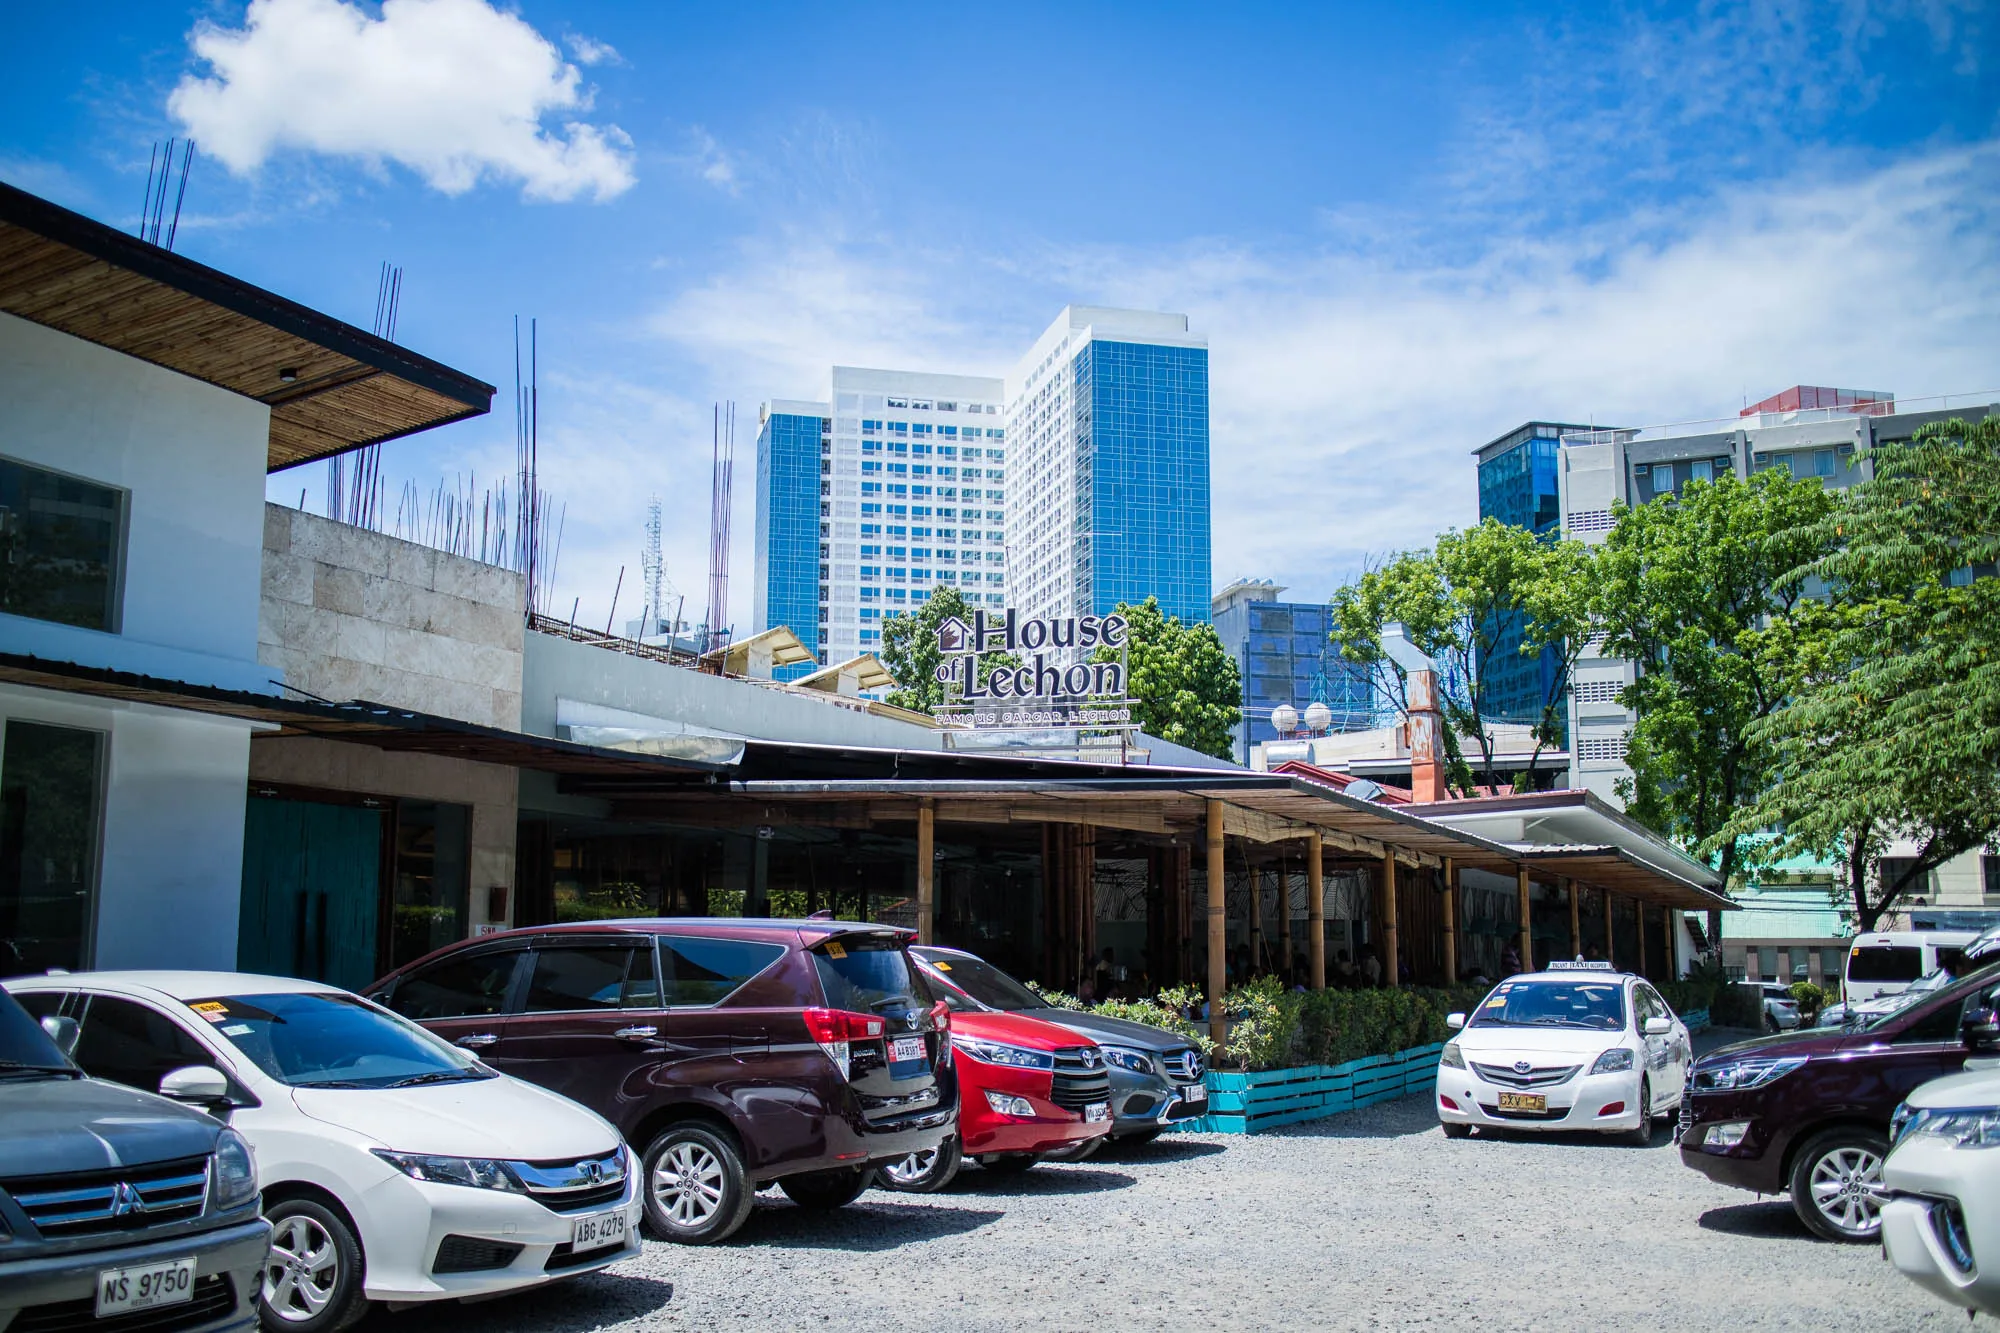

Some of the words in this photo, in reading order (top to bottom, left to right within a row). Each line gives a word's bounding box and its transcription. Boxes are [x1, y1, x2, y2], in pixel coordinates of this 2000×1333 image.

[974, 607, 1128, 652] House
[935, 658, 958, 681] of
[963, 653, 1123, 699] Lechon
[936, 712, 995, 724] FAMOUS
[1069, 710, 1130, 722] LECHON
[577, 1222, 596, 1243] ABG
[600, 1216, 624, 1238] 4279
[104, 1279, 128, 1304] NS
[138, 1268, 189, 1297] 9750
